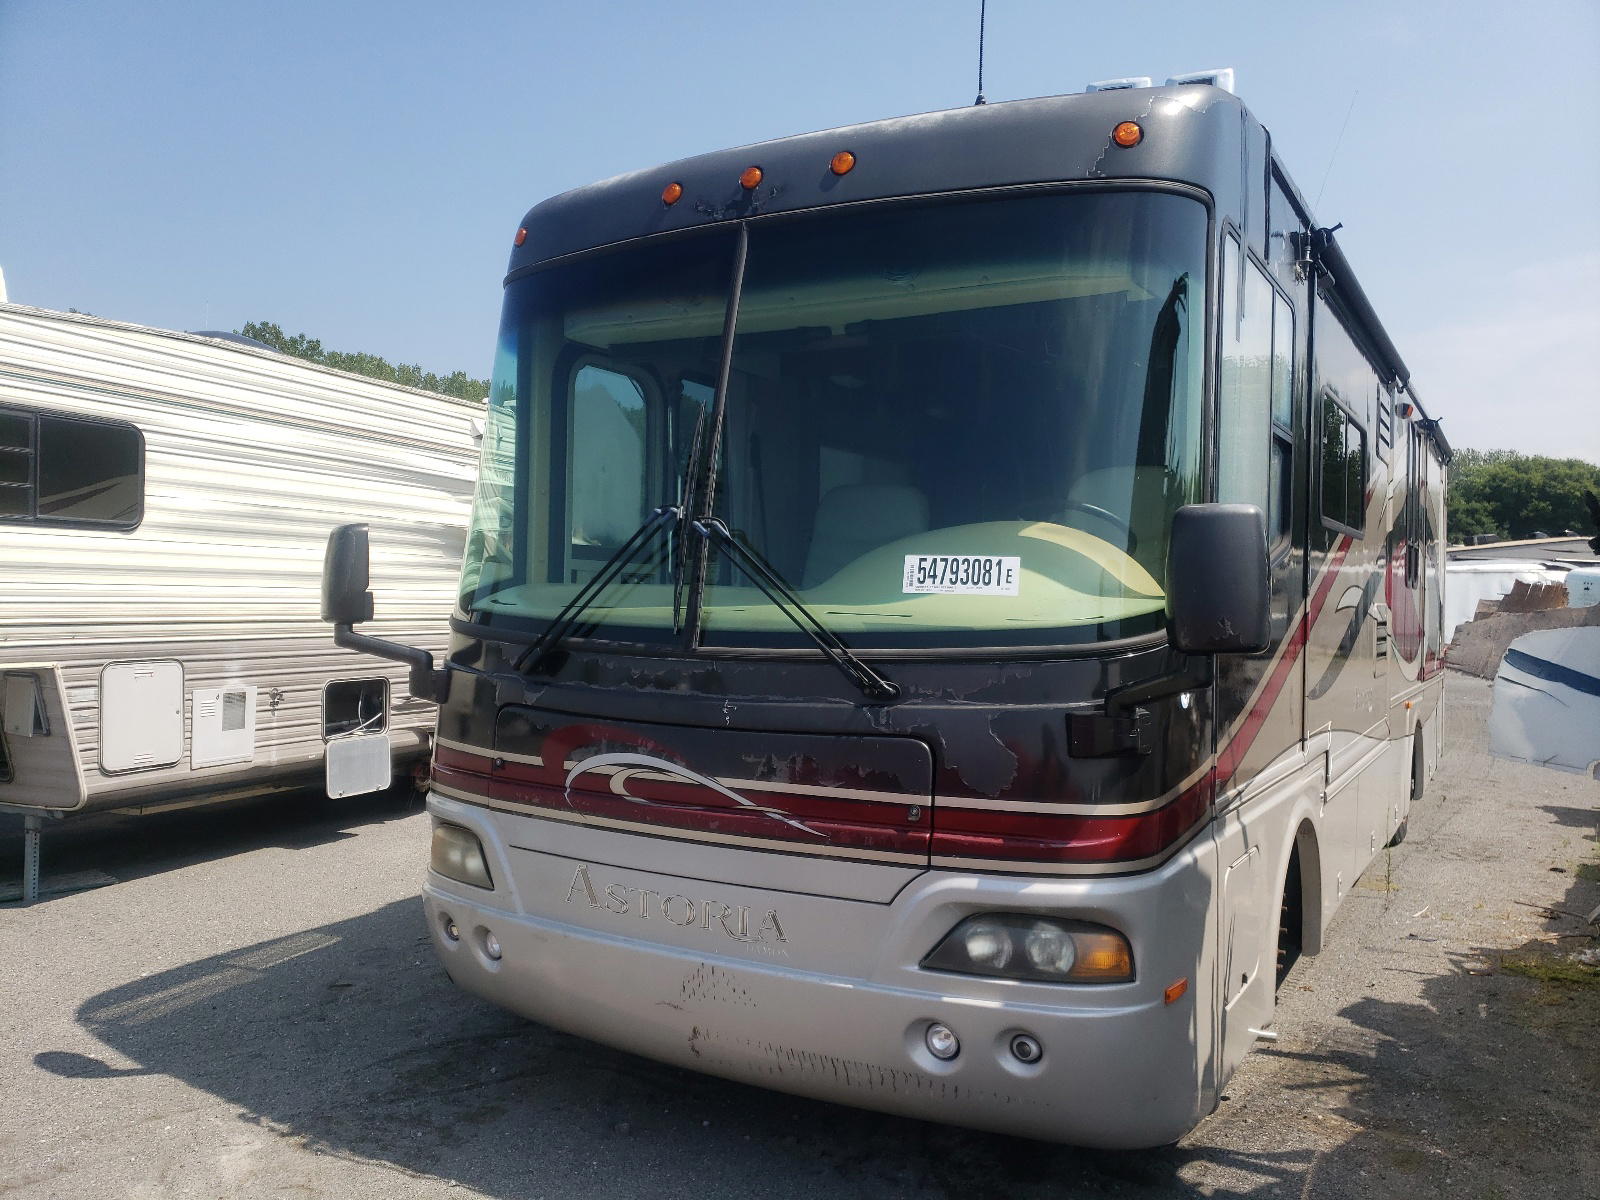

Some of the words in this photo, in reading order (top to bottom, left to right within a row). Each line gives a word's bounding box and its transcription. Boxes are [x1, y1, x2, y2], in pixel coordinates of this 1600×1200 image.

[917, 557, 1002, 586] 54793081
[1006, 568, 1013, 583] E
[564, 863, 790, 943] ASTORIA
